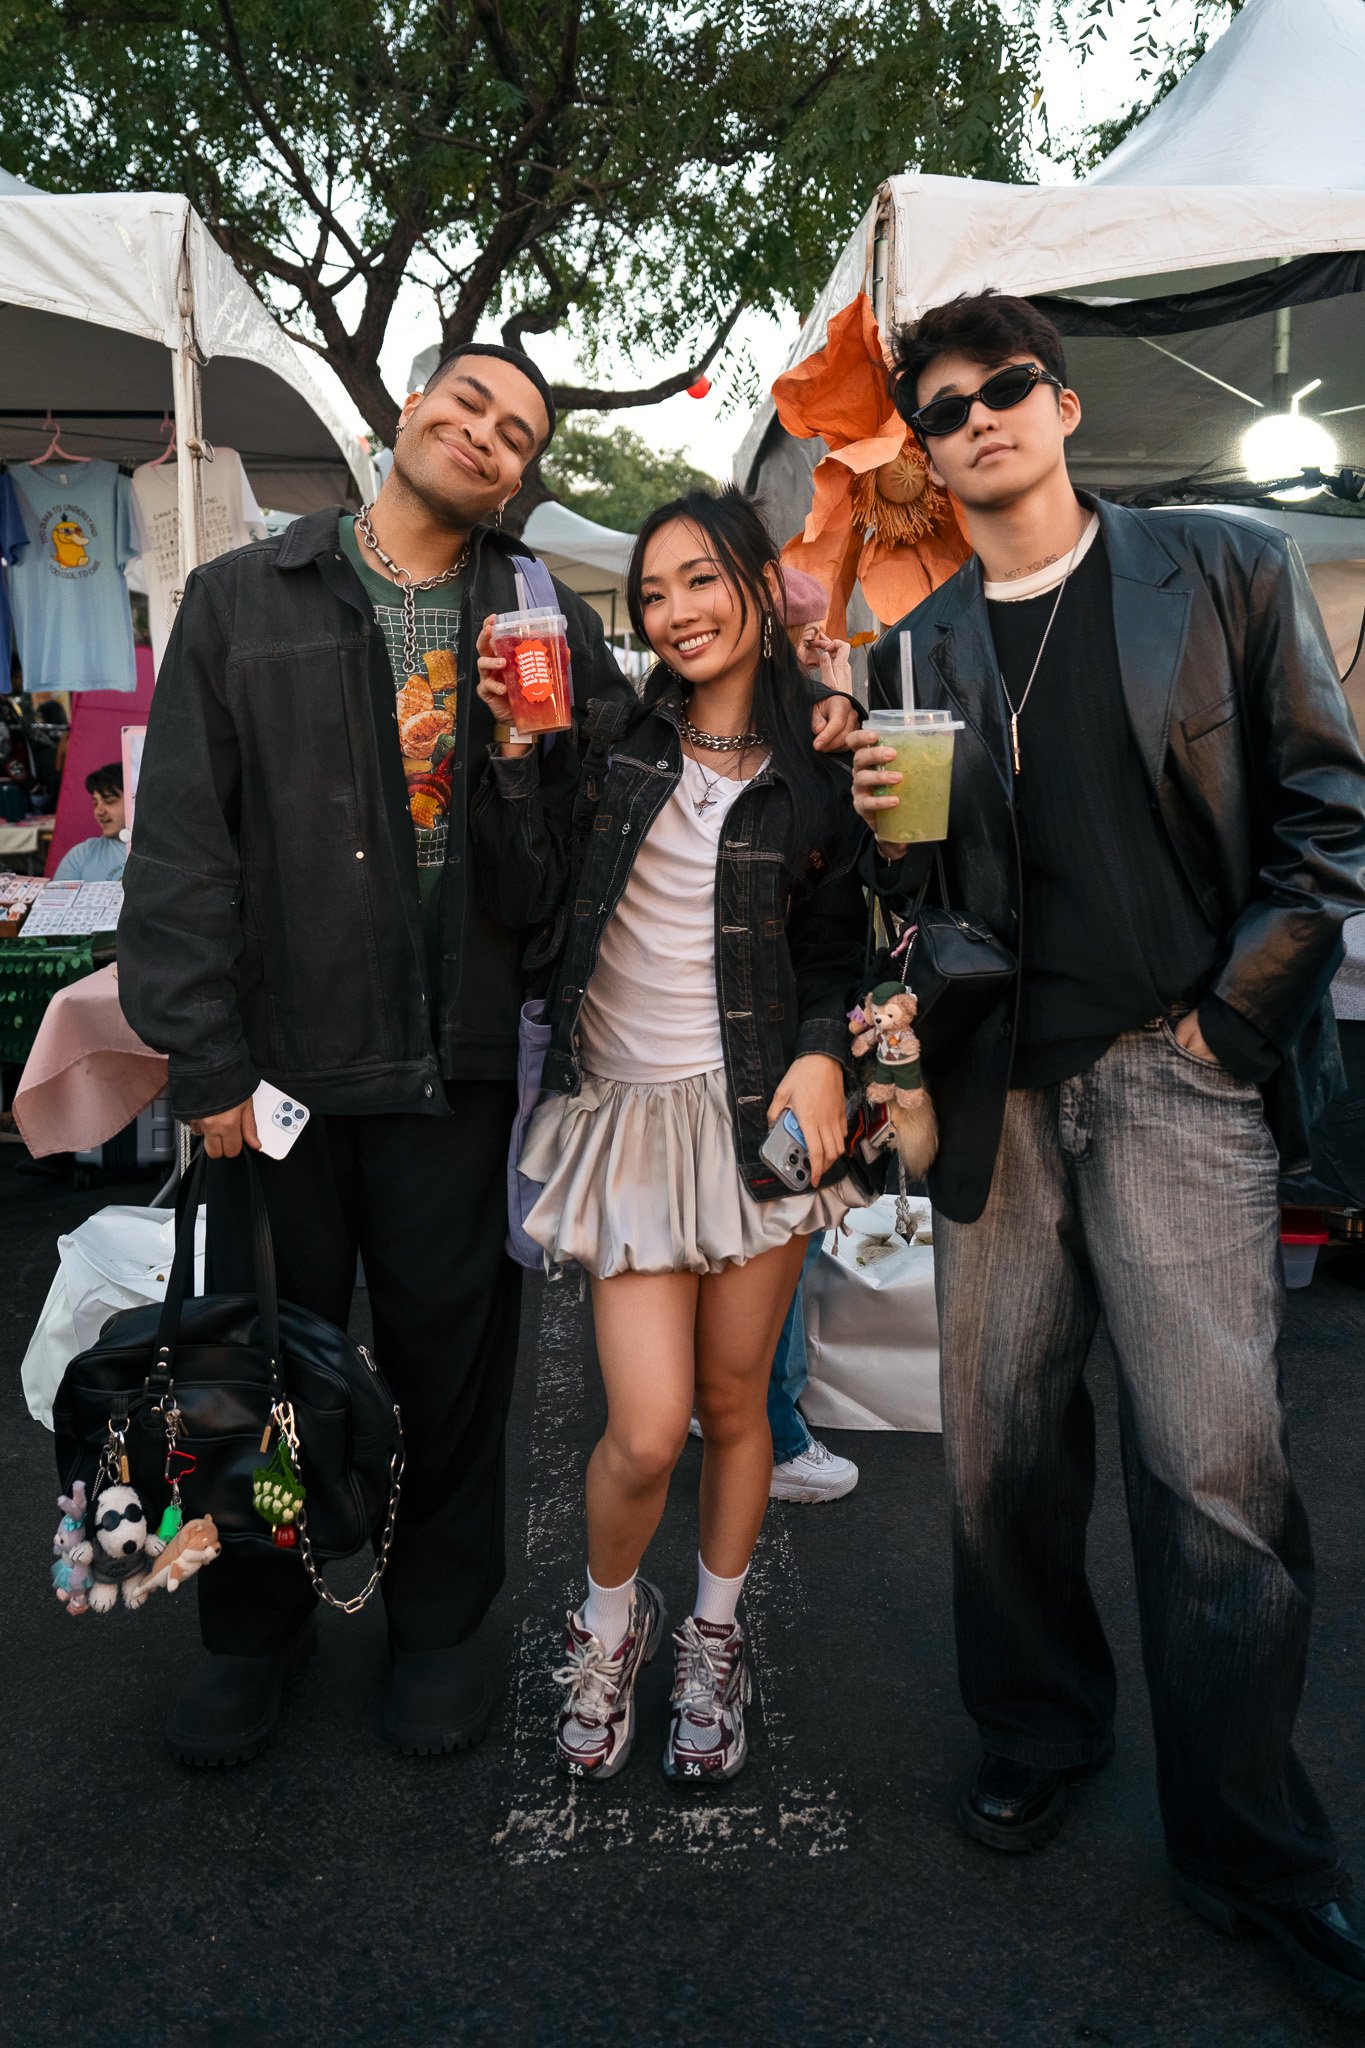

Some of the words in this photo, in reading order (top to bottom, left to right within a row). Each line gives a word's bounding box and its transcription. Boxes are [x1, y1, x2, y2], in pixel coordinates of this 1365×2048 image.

[1004, 568, 1021, 579] NOT
[1026, 554, 1059, 571] YOURS
[518, 650, 533, 659] thank
[519, 656, 535, 665] thank
[520, 662, 536, 670] thank
[521, 668, 536, 676] thank
[523, 678, 538, 687] thank
[700, 1624, 730, 1635] BALENCIAGA
[568, 1762, 584, 1776] 36
[684, 1762, 701, 1776] 36
